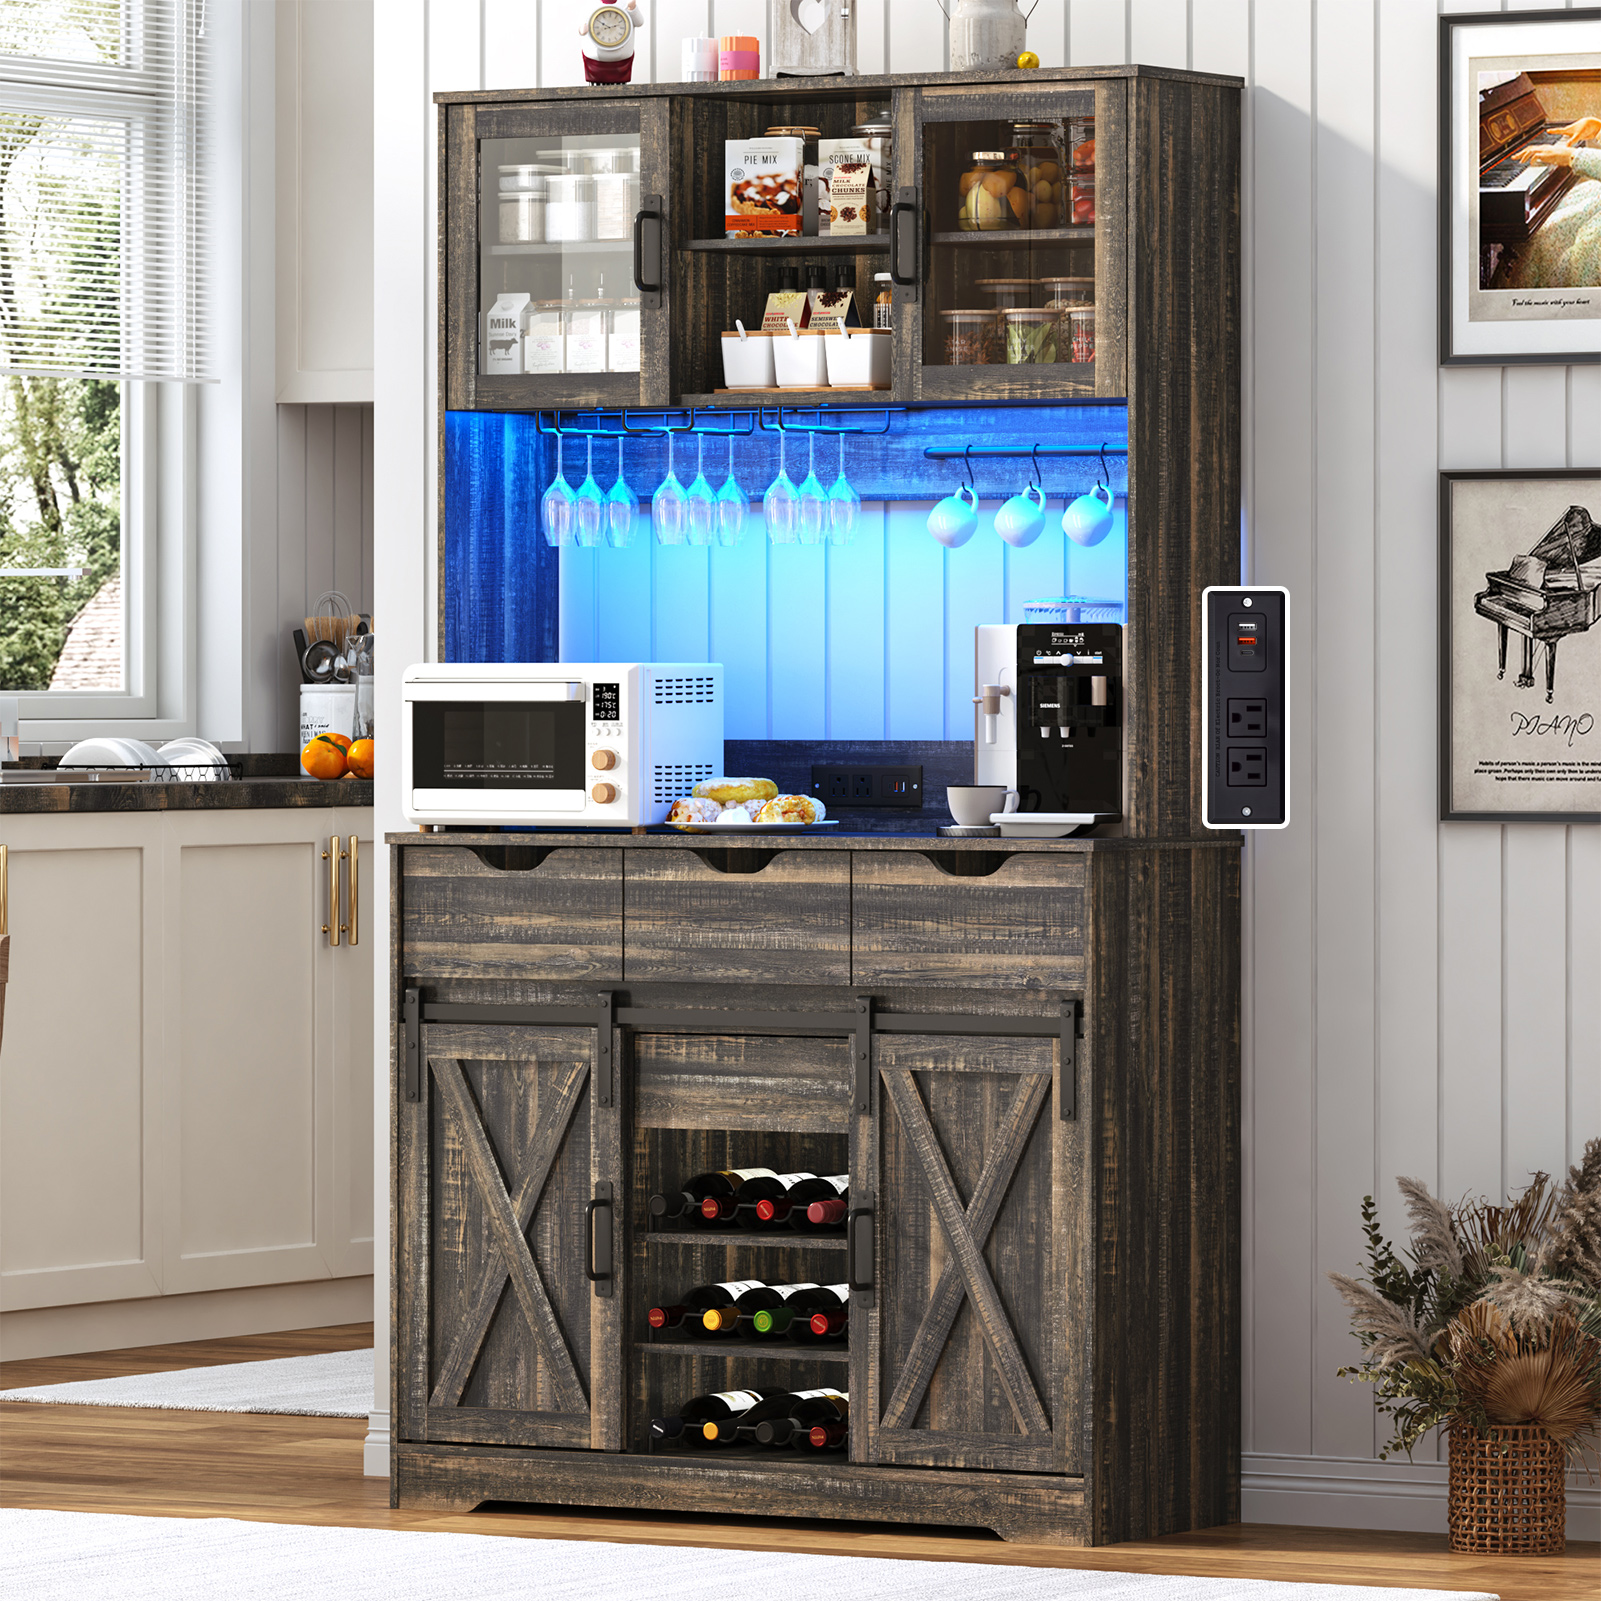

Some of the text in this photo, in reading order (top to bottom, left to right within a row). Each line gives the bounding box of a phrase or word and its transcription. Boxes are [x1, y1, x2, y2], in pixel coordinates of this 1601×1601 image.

[744, 155, 778, 165] PIE MIX
[829, 154, 870, 164] SCONE MIX
[490, 318, 516, 329] Milk
[1510, 712, 1594, 747] PIANO
